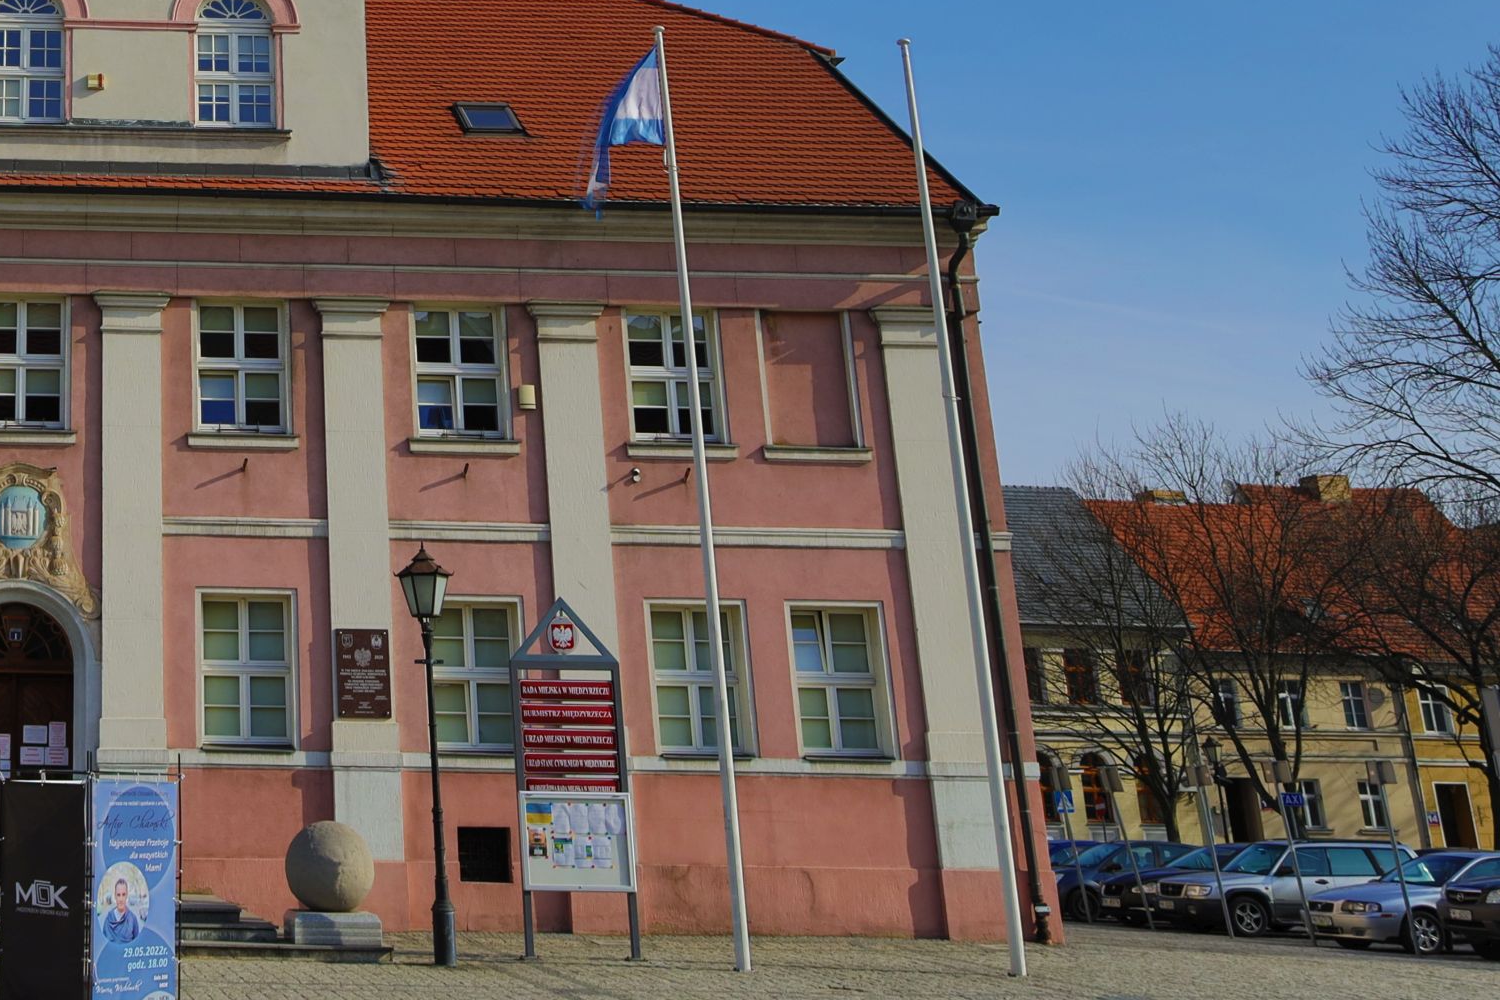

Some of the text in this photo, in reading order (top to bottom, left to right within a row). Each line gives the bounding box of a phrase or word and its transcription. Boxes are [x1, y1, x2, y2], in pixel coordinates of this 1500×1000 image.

[522, 686, 538, 694] RADA
[538, 686, 561, 694] MIEJSKA
[562, 686, 567, 694] W
[523, 709, 612, 719] BURMISTRZ MIĘDZYRZECZA
[544, 735, 565, 743] MIEJSKI
[566, 735, 571, 743] W
[123, 945, 168, 958] 29.05.2022r.
[127, 958, 168, 973] godz. 18.00
